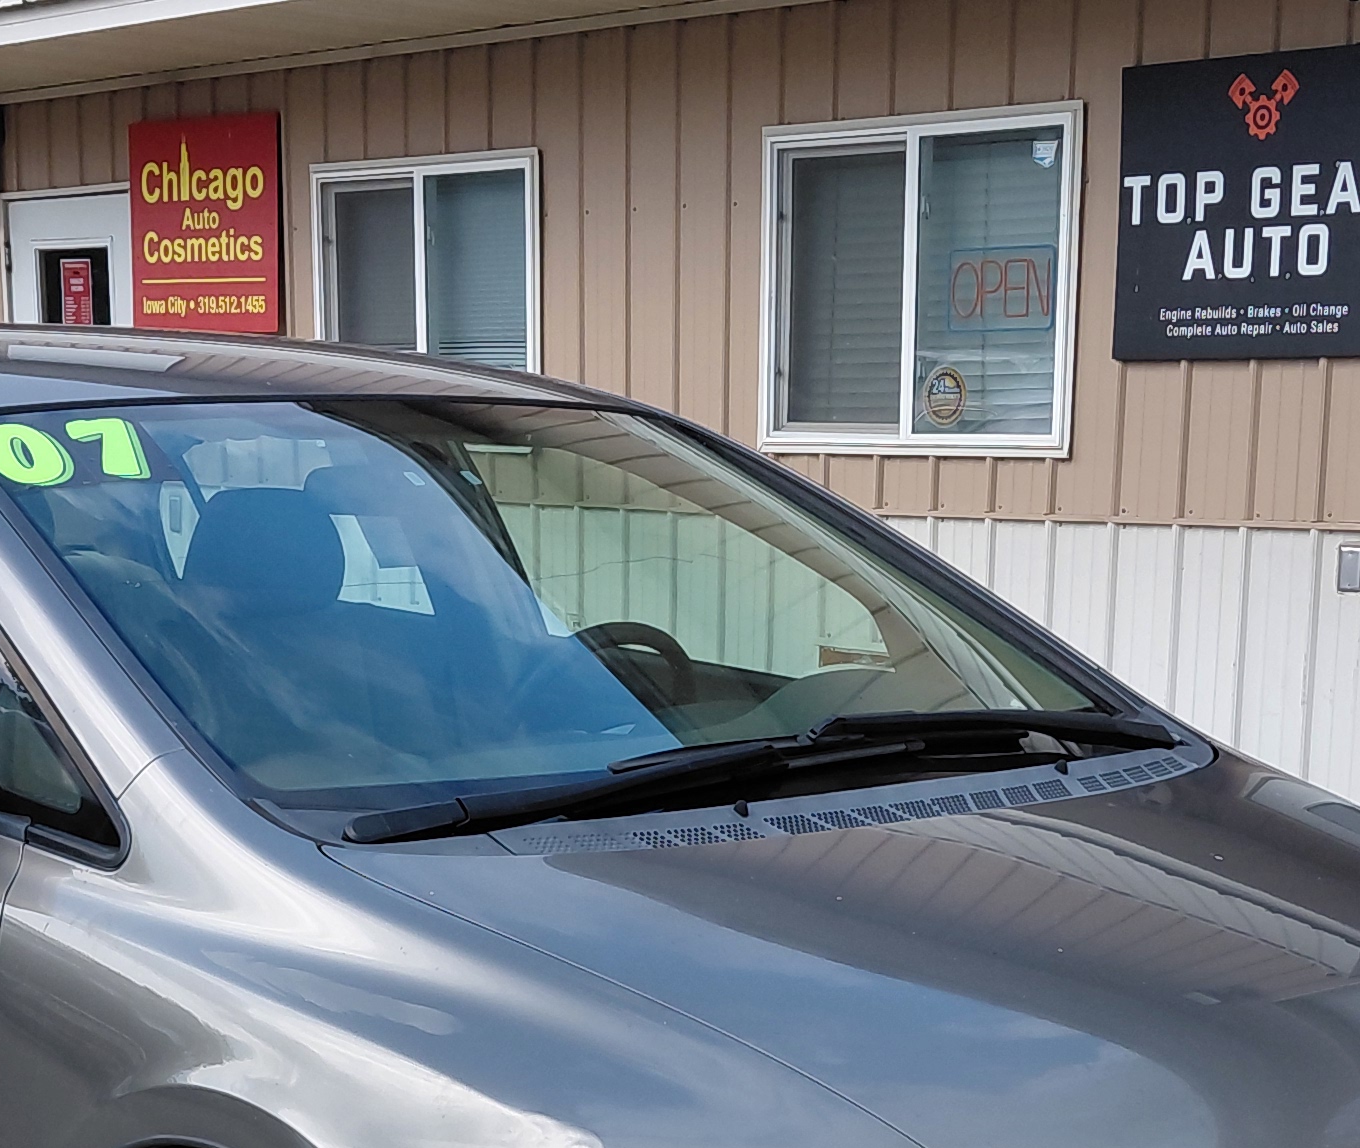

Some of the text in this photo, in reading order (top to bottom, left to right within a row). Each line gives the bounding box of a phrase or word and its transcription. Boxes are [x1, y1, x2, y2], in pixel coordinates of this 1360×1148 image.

[142, 142, 264, 210] Chicago
[1124, 170, 1224, 225] TOP
[182, 207, 219, 230] Auto
[144, 228, 262, 264] Cosmetics
[1182, 224, 1329, 280] AUTO
[952, 257, 1050, 318] OPEN
[143, 296, 265, 317] Iowa City 319.512.1455
[1160, 303, 1349, 322] Engine Rebuilds Brakes Oil Change
[1166, 320, 1339, 339] Complete Auto Repair Auto Sales
[932, 379, 945, 394] 24
